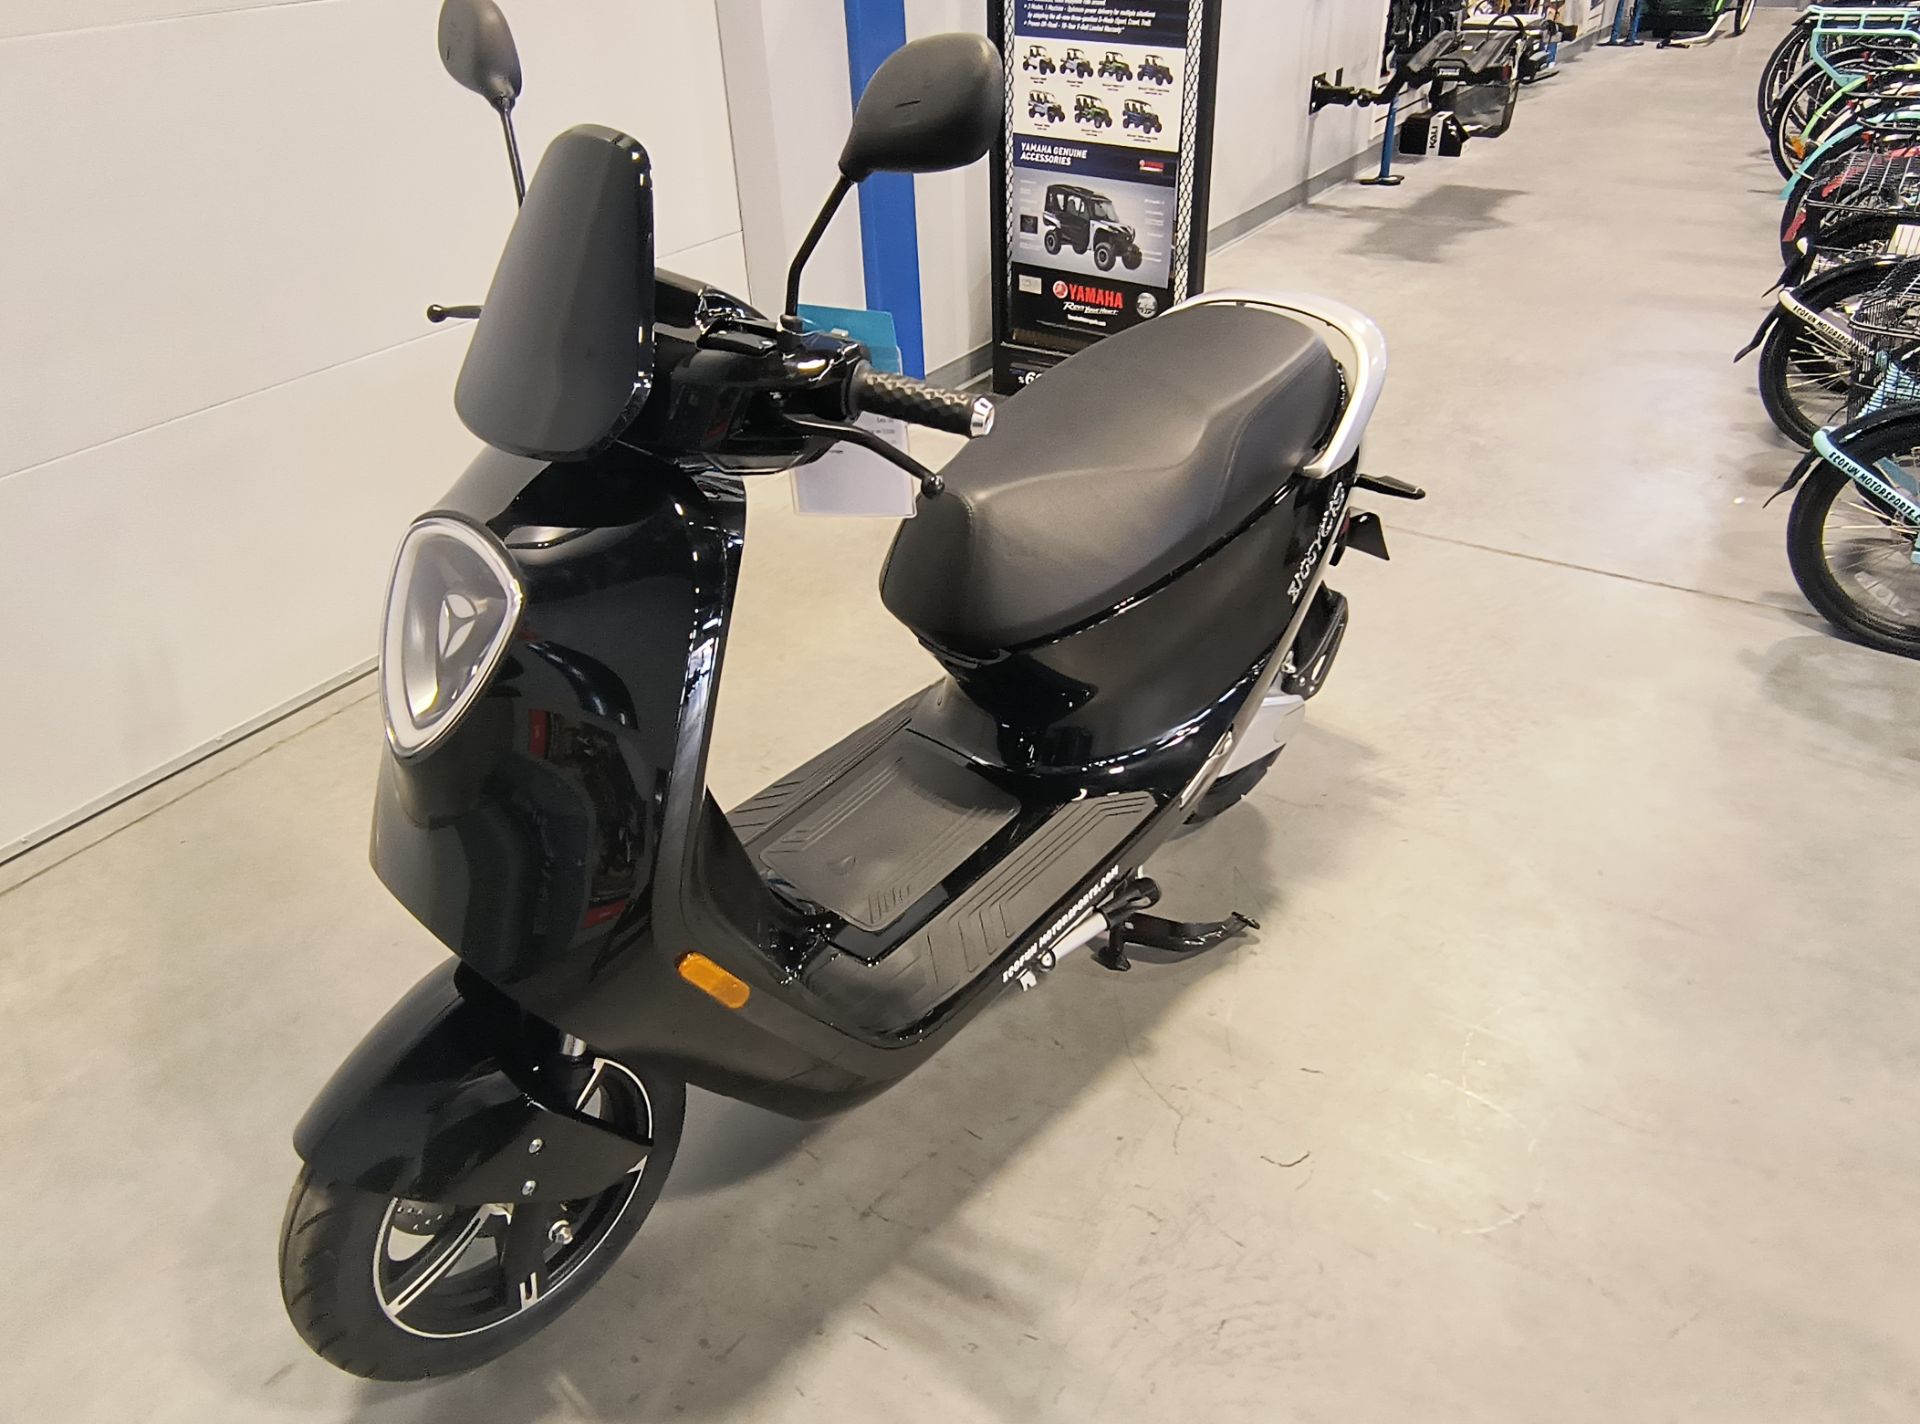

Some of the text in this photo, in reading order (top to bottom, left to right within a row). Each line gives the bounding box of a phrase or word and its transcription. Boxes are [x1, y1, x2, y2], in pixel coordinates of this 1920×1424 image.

[1020, 152, 1071, 165] ACCESSORIES
[1021, 142, 1088, 159] YAMAHA GENUINE
[1069, 284, 1124, 309] YAMAHA
[1829, 452, 1860, 477] ECOFUN
[1002, 864, 1119, 983] ECOFUN MOTORSPORTS.COM
